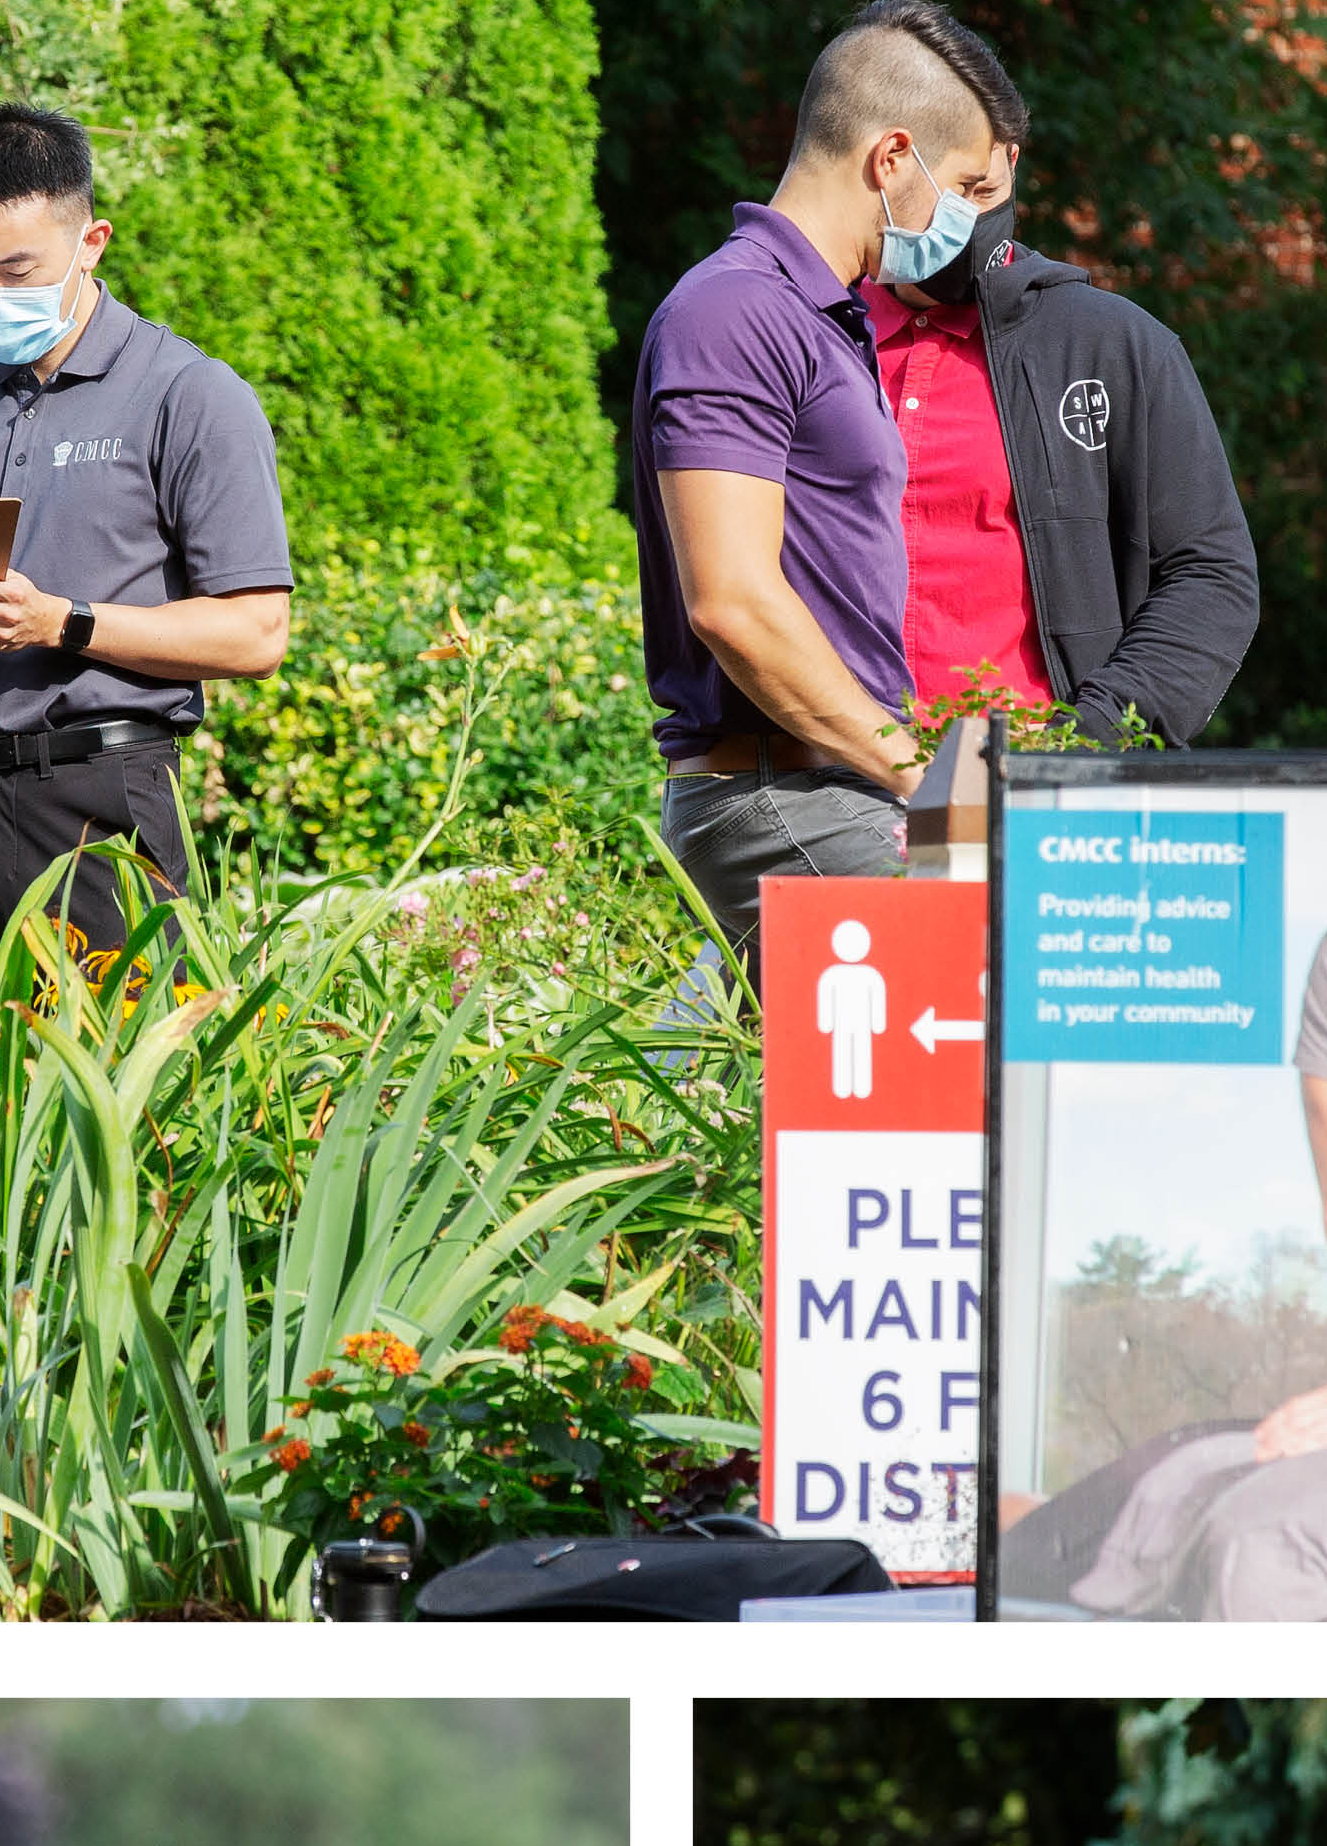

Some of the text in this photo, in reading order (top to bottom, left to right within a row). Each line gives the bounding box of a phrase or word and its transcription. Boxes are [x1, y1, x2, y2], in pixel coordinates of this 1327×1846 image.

[75, 437, 122, 462] CMCC
[1037, 835, 1247, 865] CMCC interns:
[1037, 893, 1231, 923] Providing advice
[1037, 929, 1172, 953] and care to
[1037, 965, 1221, 989] maintain health
[1037, 999, 1255, 1029] in your community
[862, 1370, 903, 1431] 6
[796, 1462, 978, 1522] DIST
